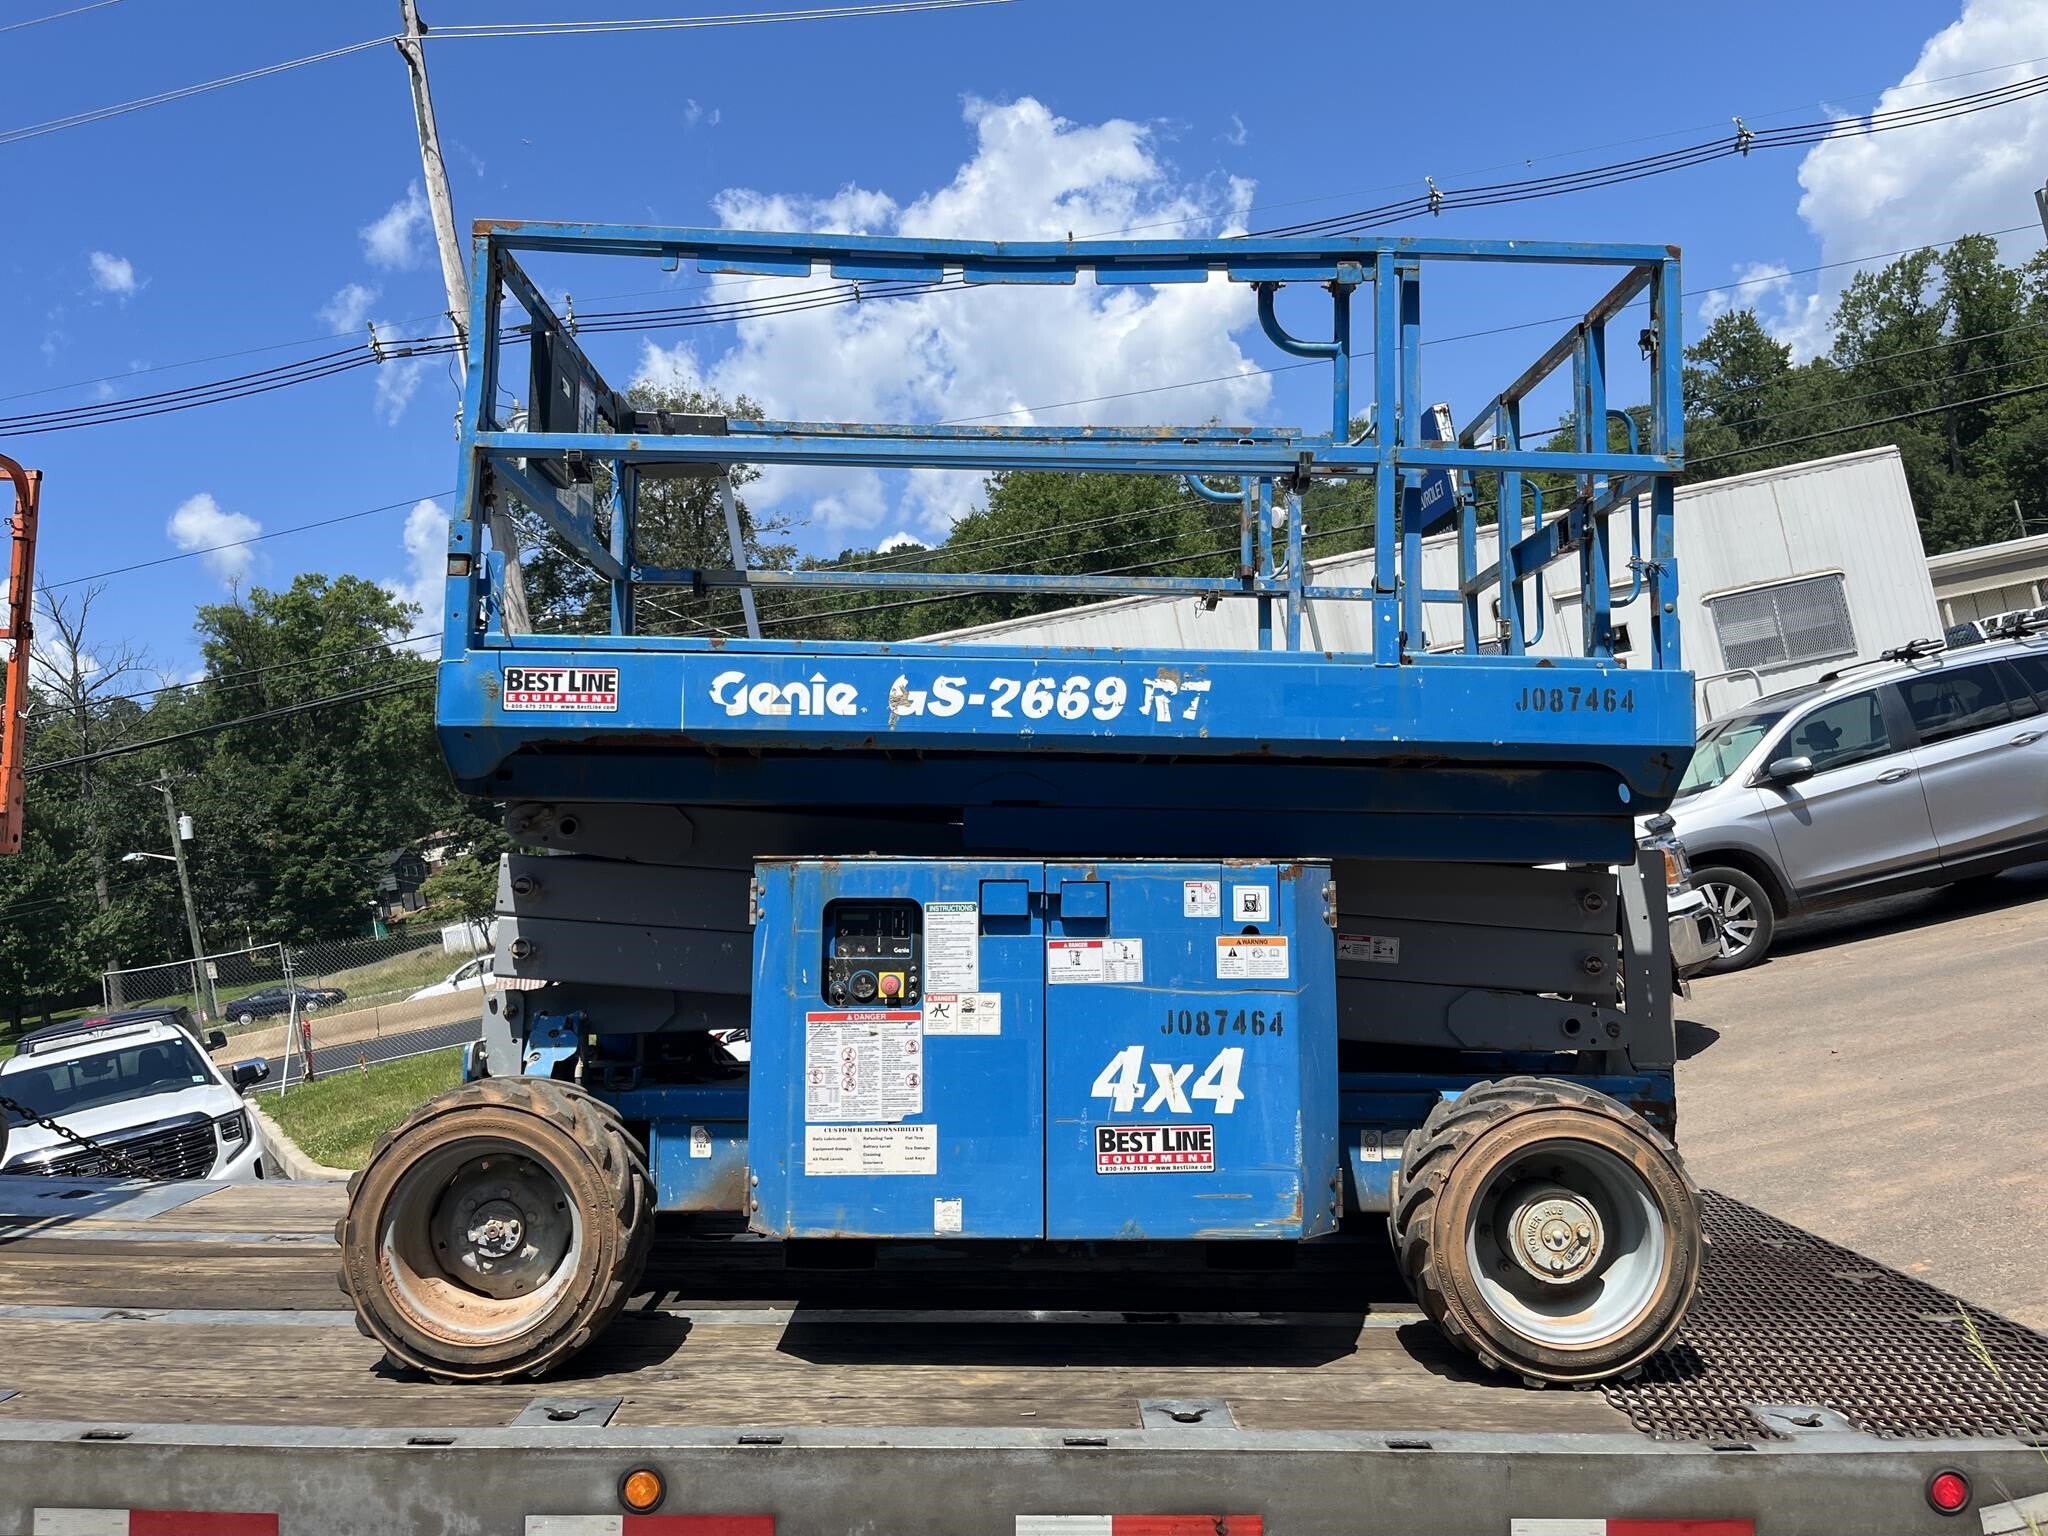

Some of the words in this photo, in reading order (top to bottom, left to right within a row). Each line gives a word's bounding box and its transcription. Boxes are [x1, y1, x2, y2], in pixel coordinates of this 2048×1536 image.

[507, 669, 563, 692] BEST
[568, 670, 616, 692] LINE
[507, 693, 614, 703] EQUIPMENT
[709, 671, 859, 716] Genie
[889, 674, 1128, 721] GS-2669
[1138, 677, 1212, 722] RT
[1515, 686, 1635, 713] J087464
[929, 903, 974, 912] INSTRUCTIONS
[893, 946, 910, 954] Genie
[853, 1013, 887, 1021] DANGER
[1160, 1009, 1284, 1037] J087464
[1090, 1045, 1245, 1115] 4x4
[1098, 1128, 1157, 1153] BEST
[1162, 1127, 1212, 1151] LINE
[1100, 1153, 1210, 1164] EQUIPMENT
[1527, 1215, 1542, 1254] POWER
[1543, 1205, 1565, 1217] HUB
